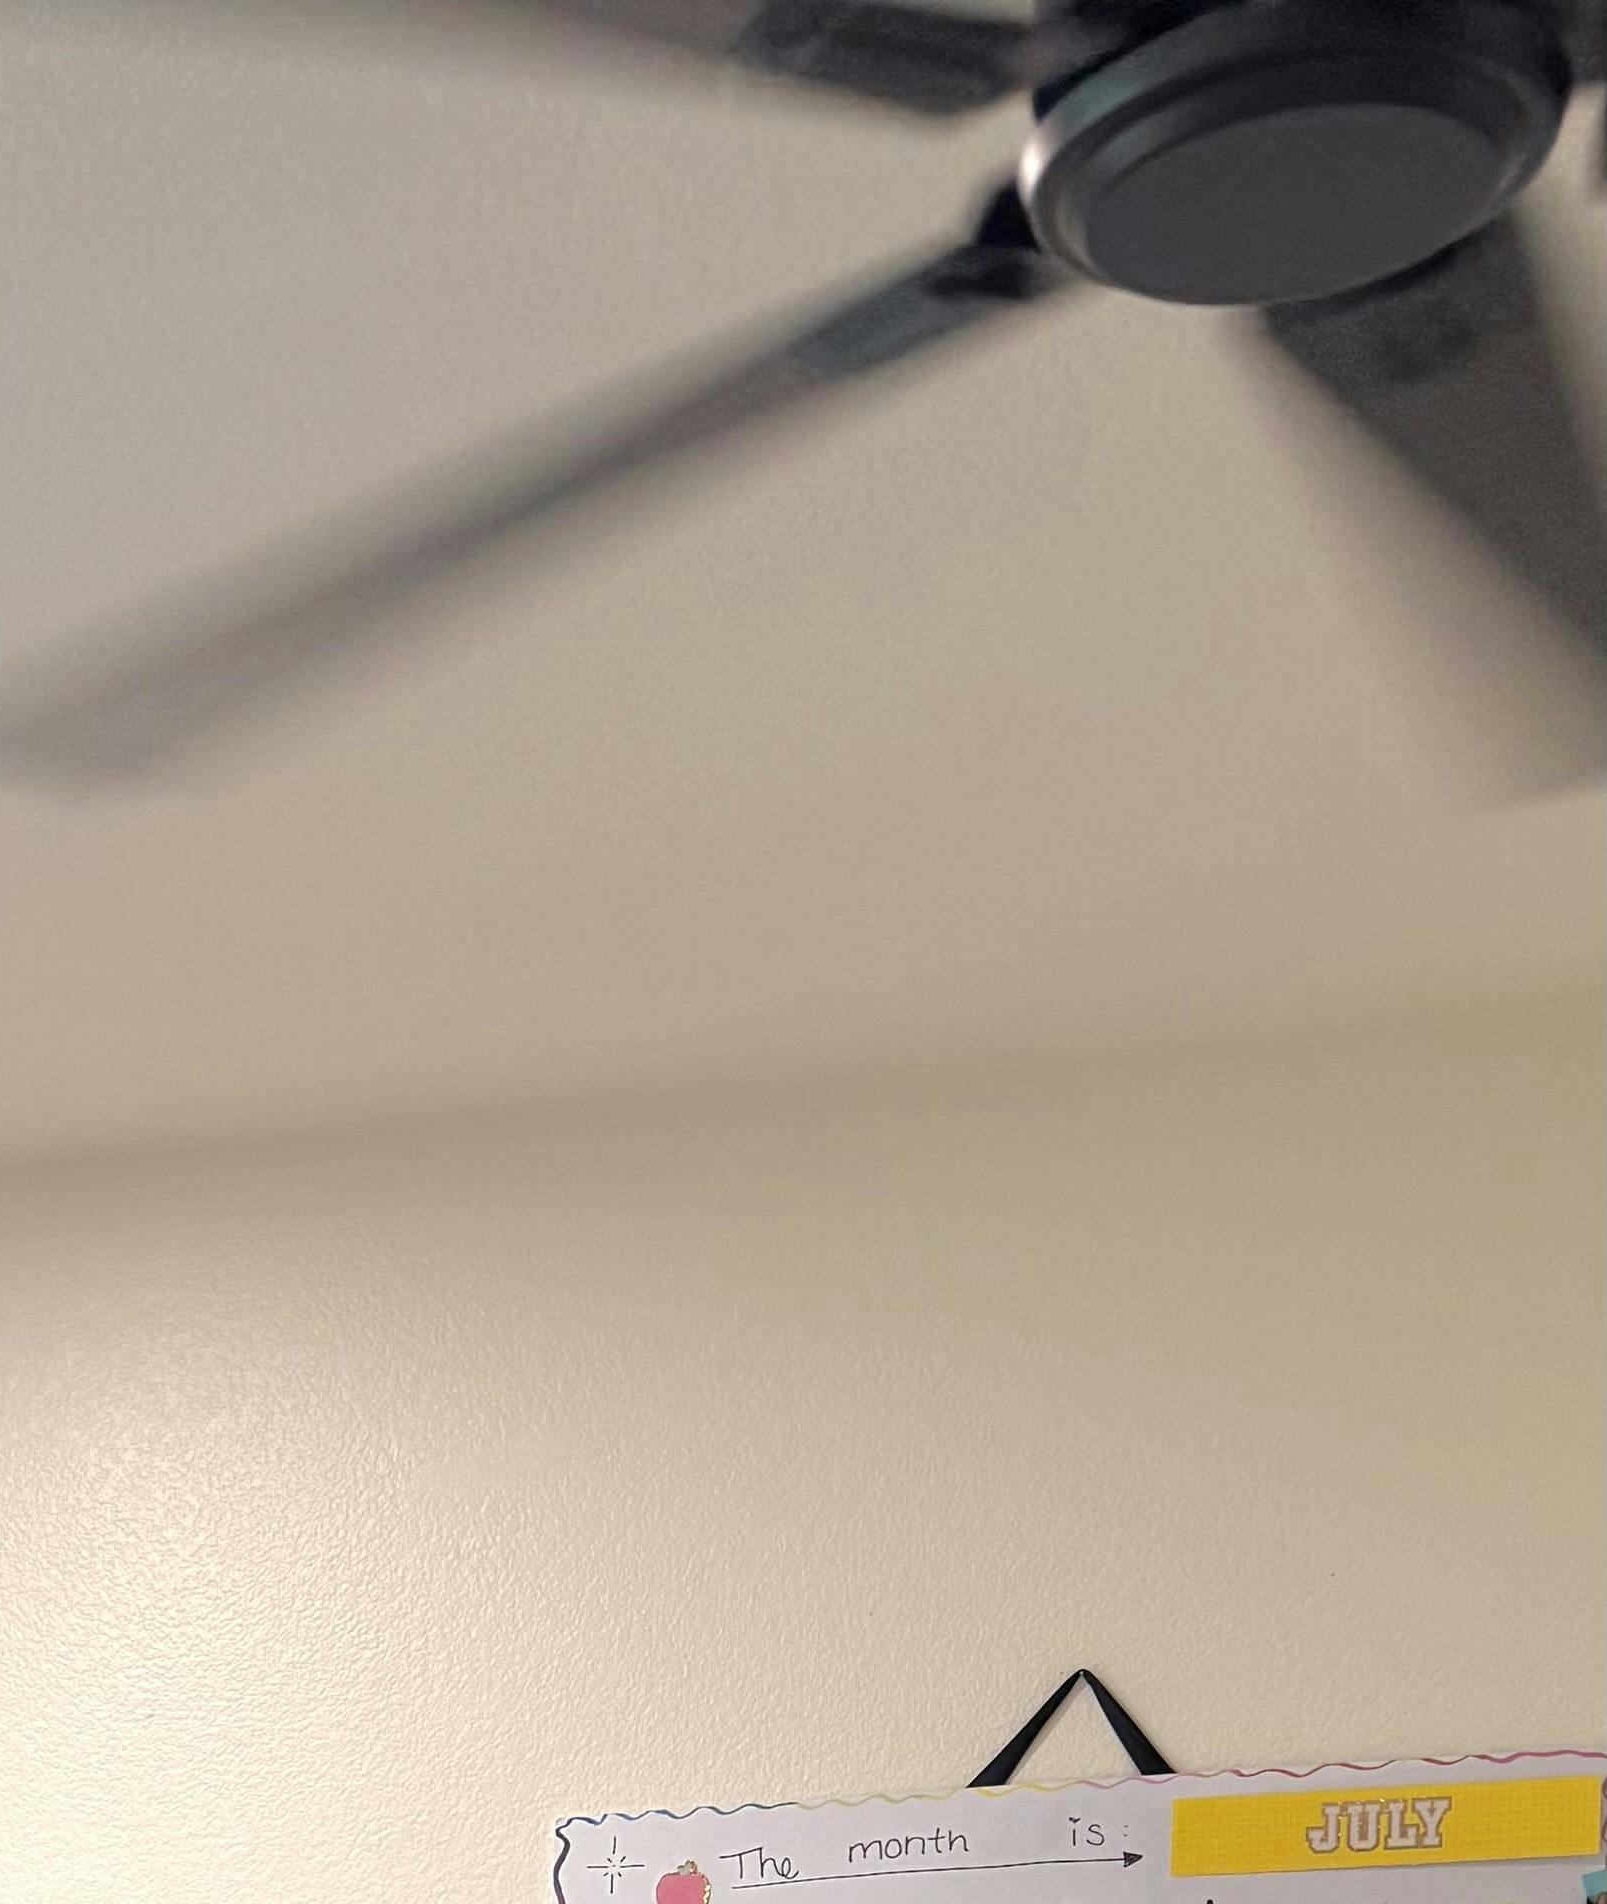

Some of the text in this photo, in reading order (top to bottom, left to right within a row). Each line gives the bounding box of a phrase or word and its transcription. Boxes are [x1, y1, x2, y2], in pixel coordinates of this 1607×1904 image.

[1305, 1796, 1452, 1855] JULY
[720, 1846, 799, 1881] The
[847, 1828, 970, 1866] month
